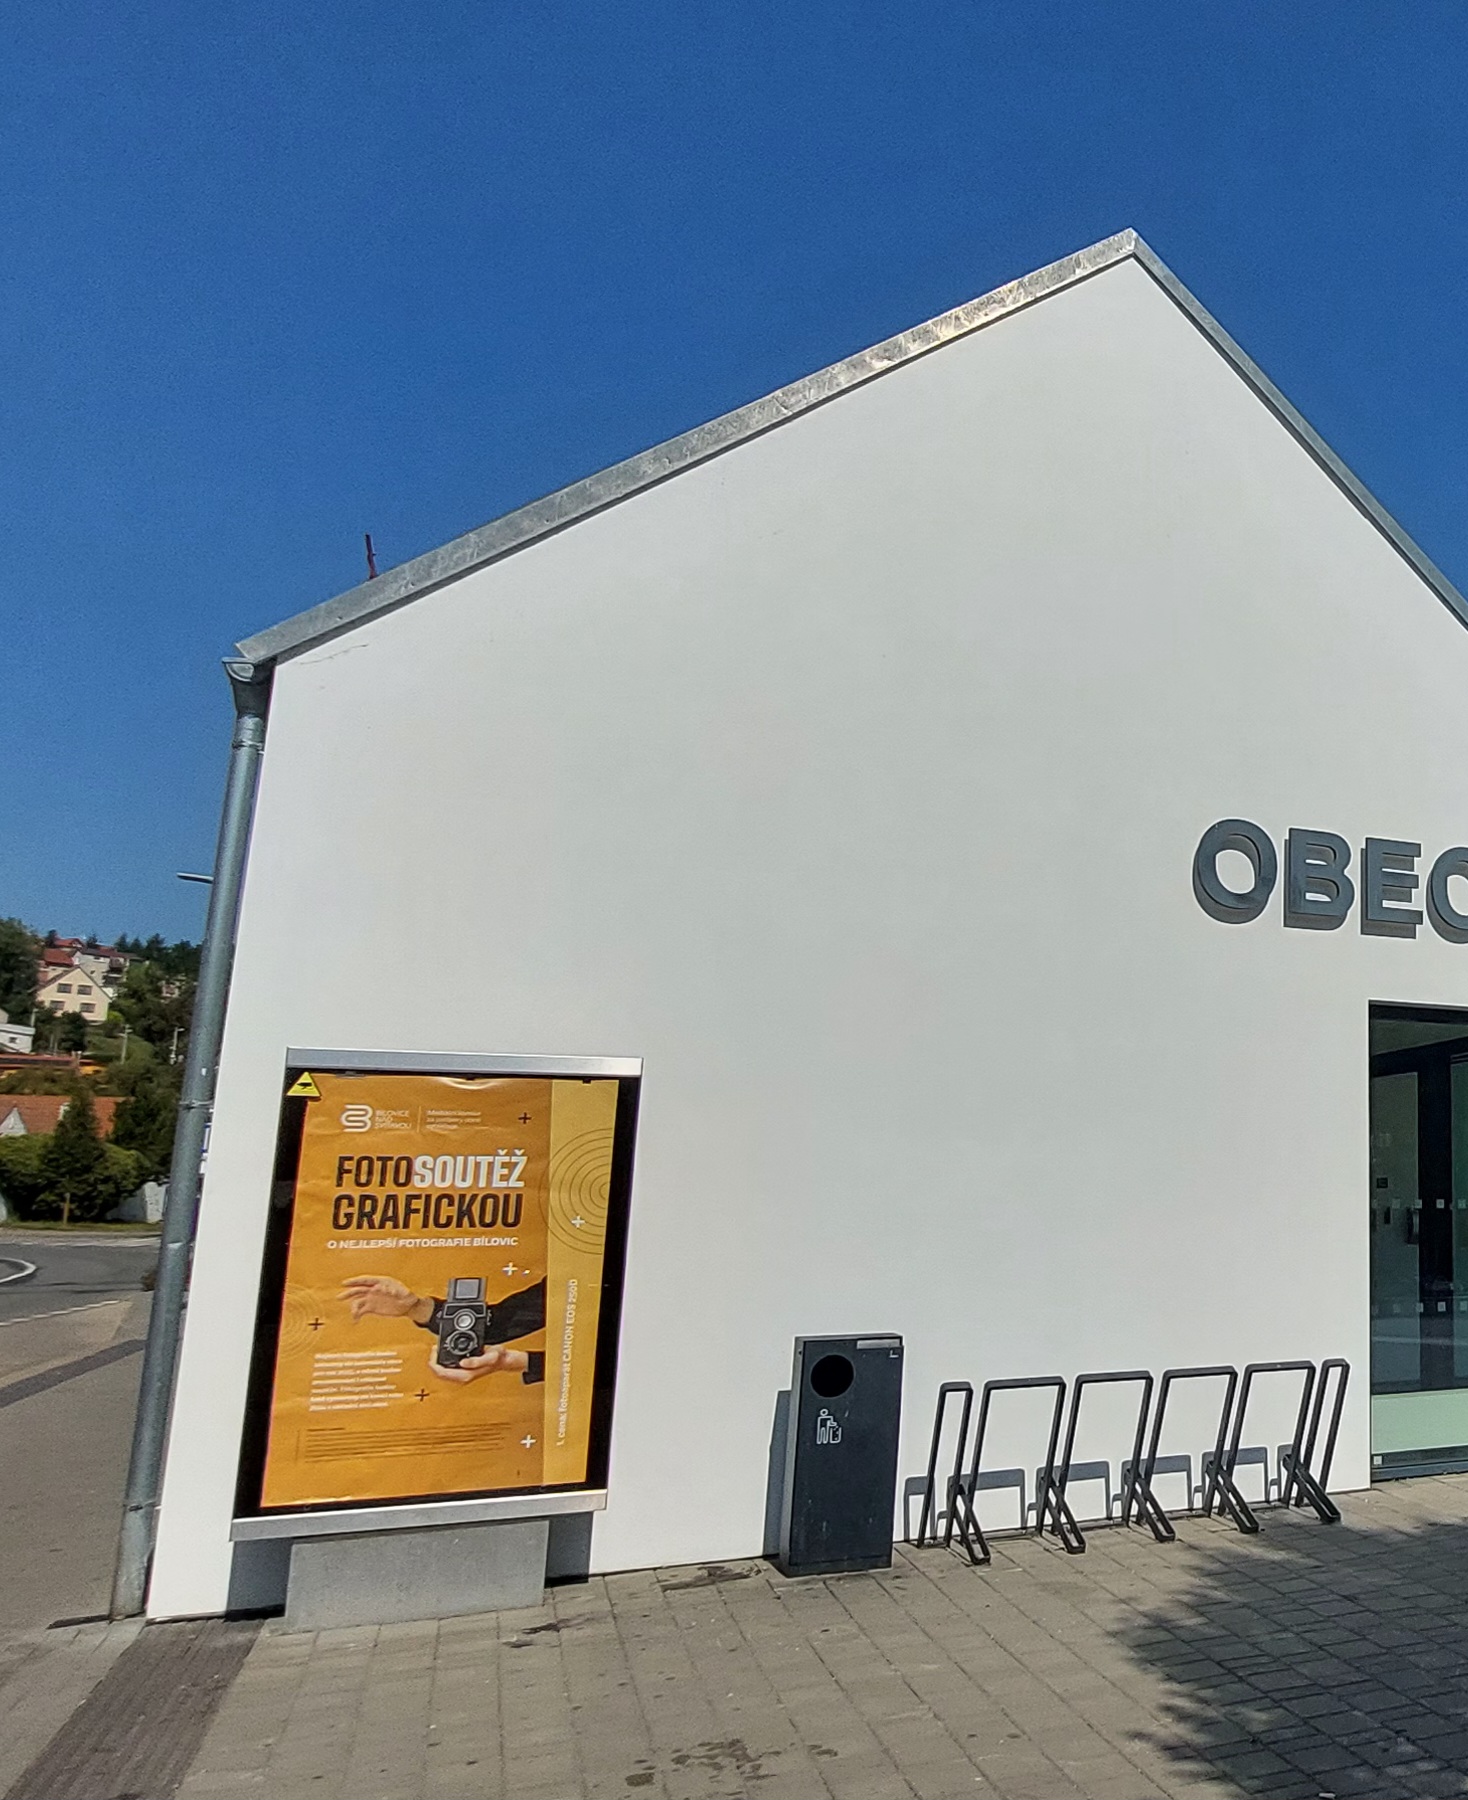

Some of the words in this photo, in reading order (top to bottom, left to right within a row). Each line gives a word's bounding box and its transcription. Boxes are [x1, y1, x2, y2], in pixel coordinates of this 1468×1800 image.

[335, 1149, 528, 1188] FOTOSOUTĚŽ
[332, 1193, 524, 1230] GRAFICKOU
[327, 1240, 337, 1249] O
[340, 1237, 397, 1248] NEJLEPŠÍ
[399, 1237, 472, 1248] FOTOGRAFIE
[473, 1236, 518, 1247] BÍLOVIC
[566, 1304, 577, 1324] EOS
[563, 1326, 574, 1362] CANON
